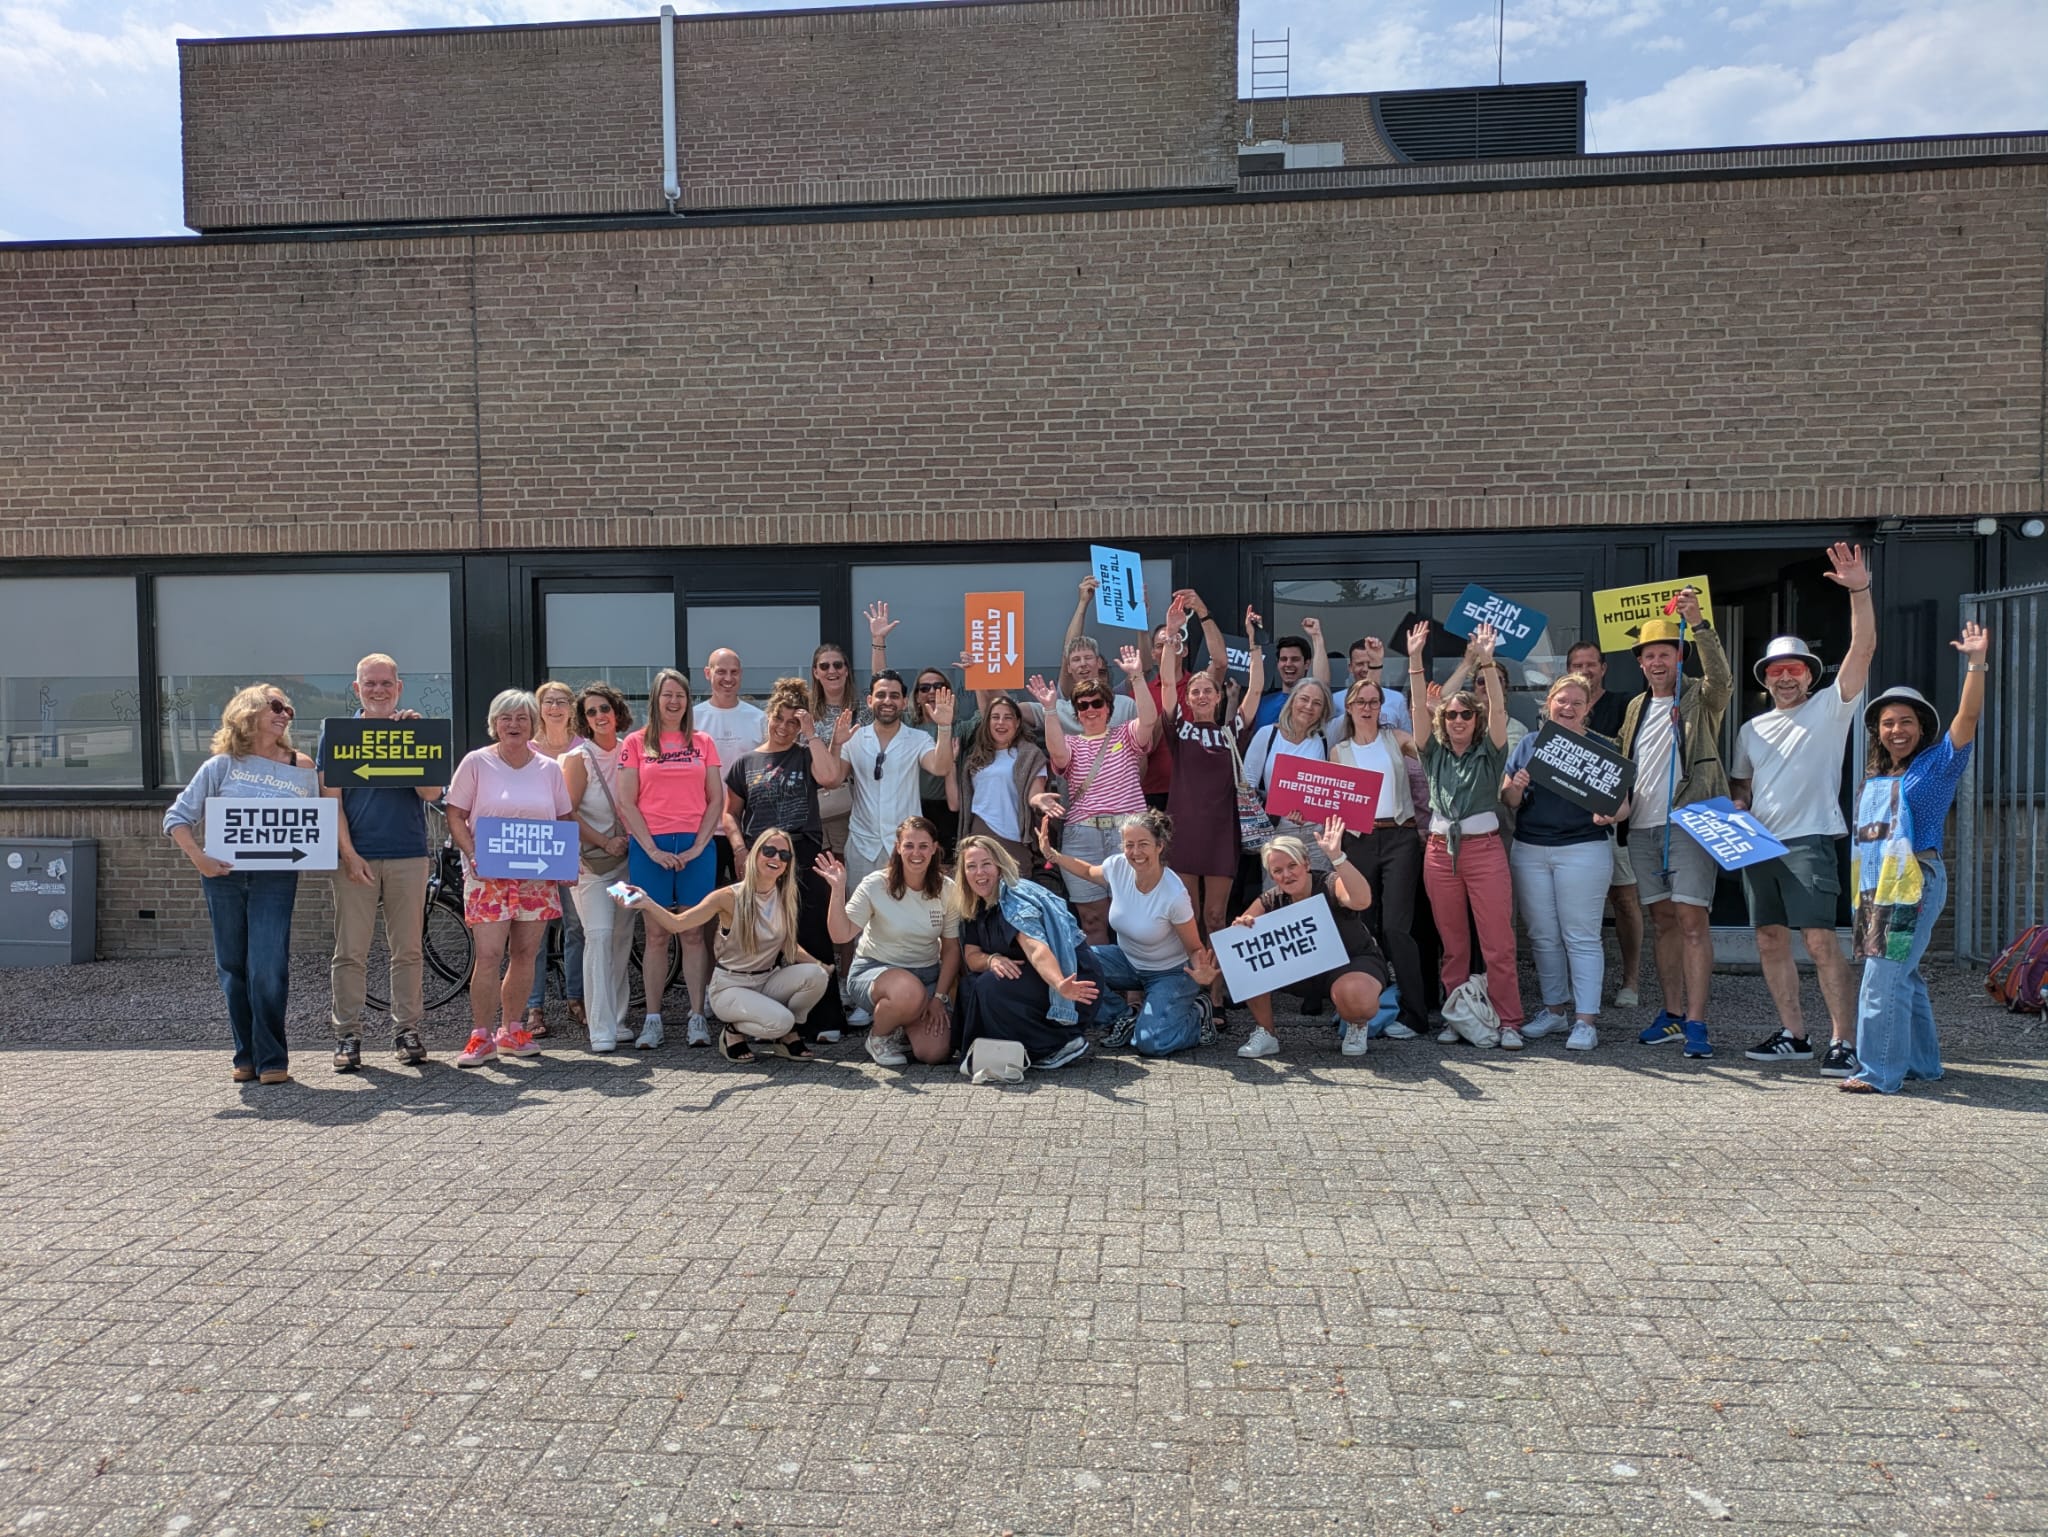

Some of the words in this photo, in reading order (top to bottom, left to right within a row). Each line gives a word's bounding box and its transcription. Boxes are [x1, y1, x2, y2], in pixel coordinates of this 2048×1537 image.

[1110, 554, 1120, 572] ALL
[1463, 602, 1530, 639] SCHULD
[971, 620, 984, 663] HAAR
[988, 608, 1001, 673] SCHULD
[362, 730, 415, 744] EFFE
[621, 749, 629, 762] 6
[225, 808, 318, 826] STOOR
[224, 828, 320, 844] ZENDER
[501, 822, 554, 840] HAAR
[488, 837, 566, 856] SCHULD
[1231, 916, 1318, 958] THANKS
[1245, 950, 1275, 972] TO
[1279, 935, 1318, 961] ME!
